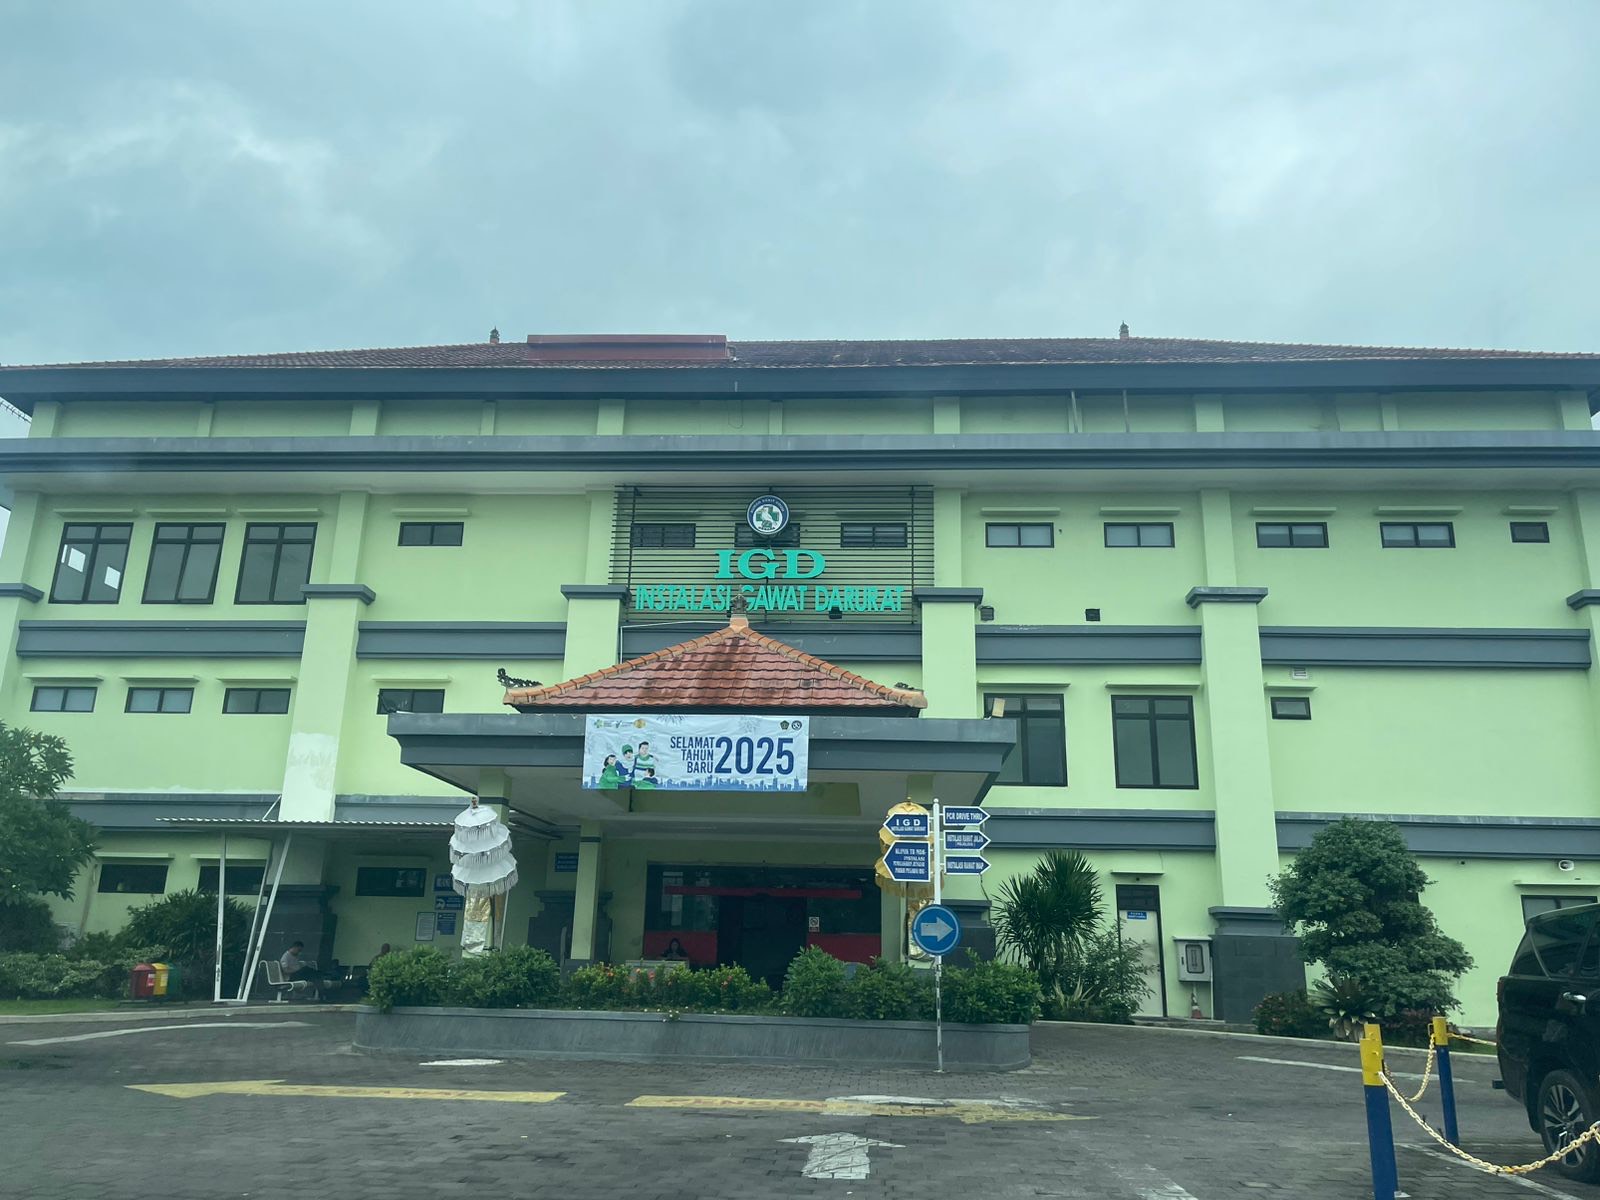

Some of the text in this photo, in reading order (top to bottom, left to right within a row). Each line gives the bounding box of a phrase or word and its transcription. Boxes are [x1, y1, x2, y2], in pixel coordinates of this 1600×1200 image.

[714, 549, 826, 580] IGD
[635, 584, 905, 612] INSTALASI GAWAT DARURAT
[670, 736, 715, 749] SELAMAT
[682, 749, 714, 761] TAHUN
[714, 736, 795, 775] 2025
[686, 761, 714, 774] BARU
[946, 812, 955, 820] PCR
[956, 812, 970, 820] DRIVE
